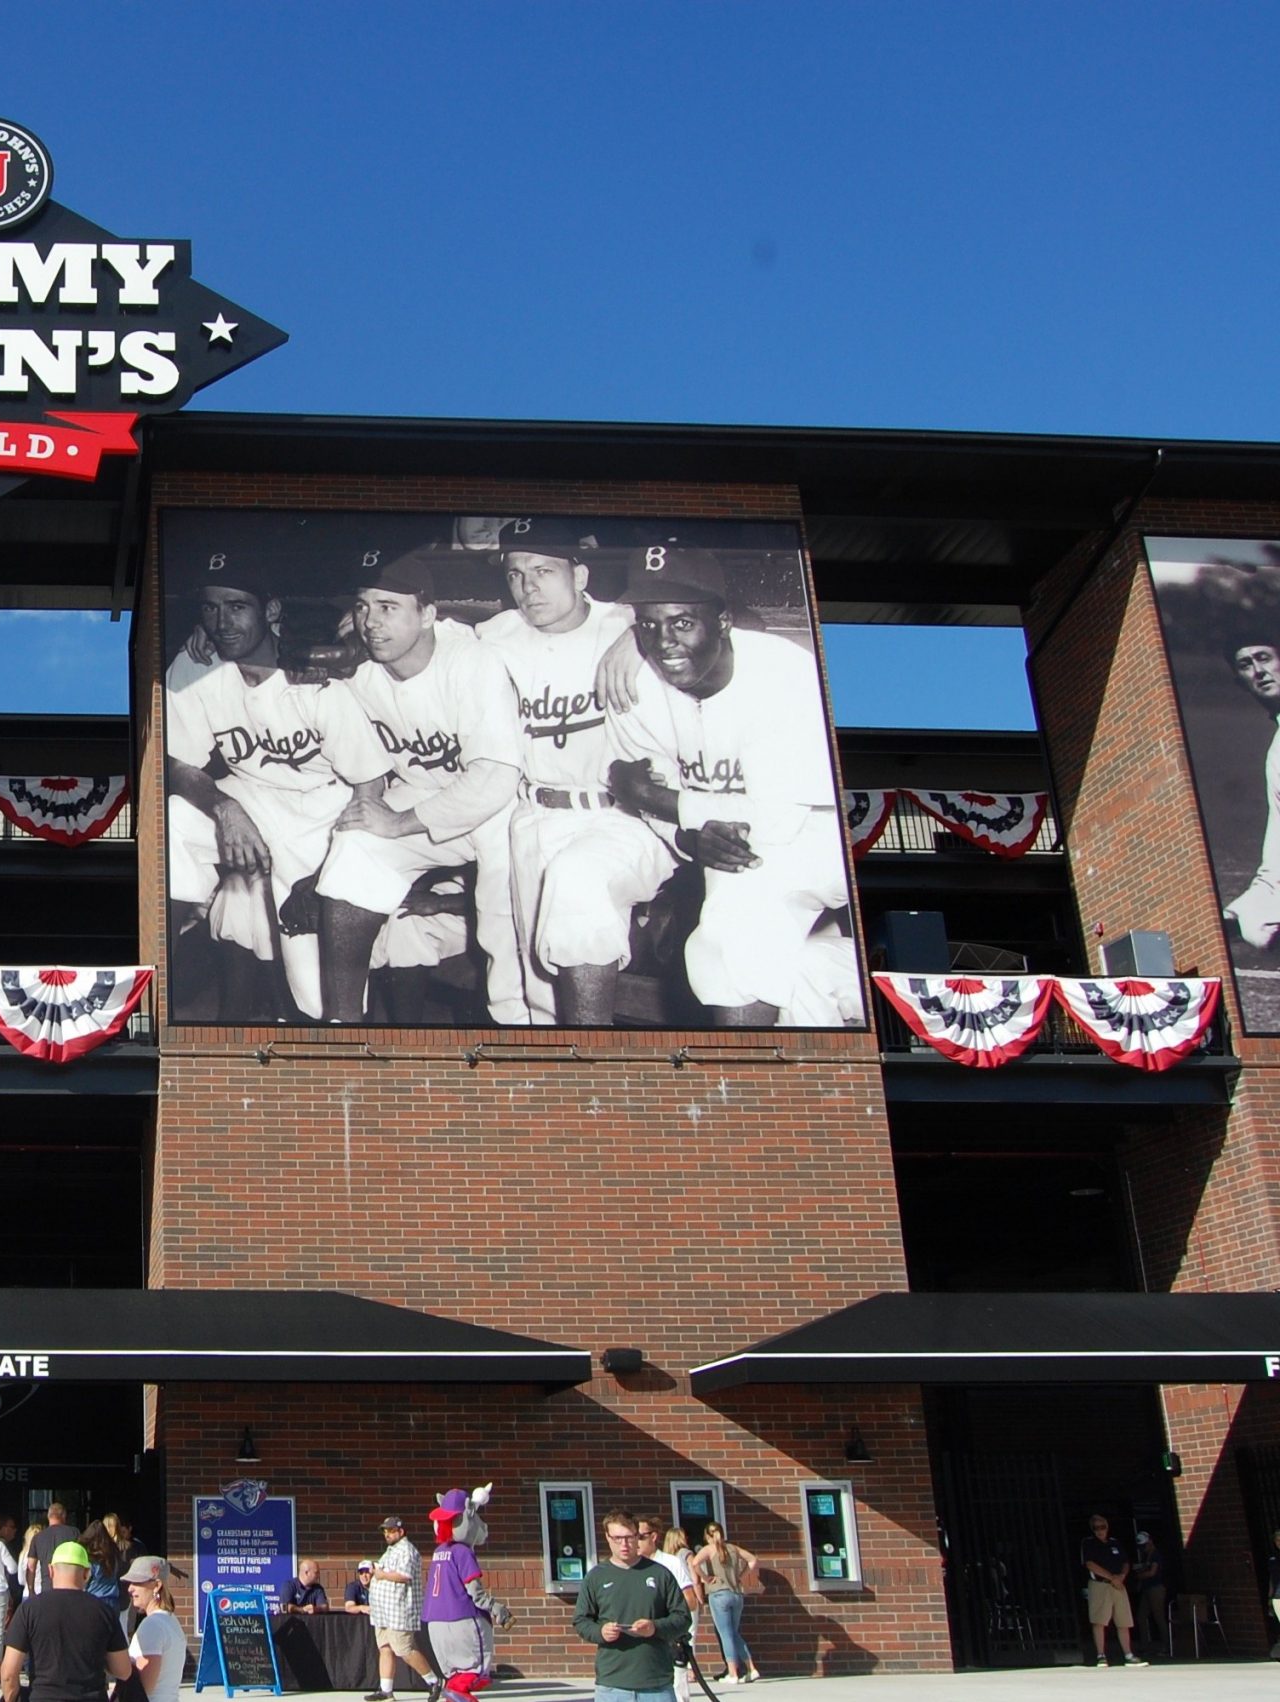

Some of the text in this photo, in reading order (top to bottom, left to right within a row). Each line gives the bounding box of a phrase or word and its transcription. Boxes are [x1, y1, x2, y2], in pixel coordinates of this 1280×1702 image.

[645, 545, 666, 571] B
[217, 1565, 229, 1574] LEFT
[230, 1565, 245, 1574] FIELD
[233, 1599, 258, 1611] pepsi
